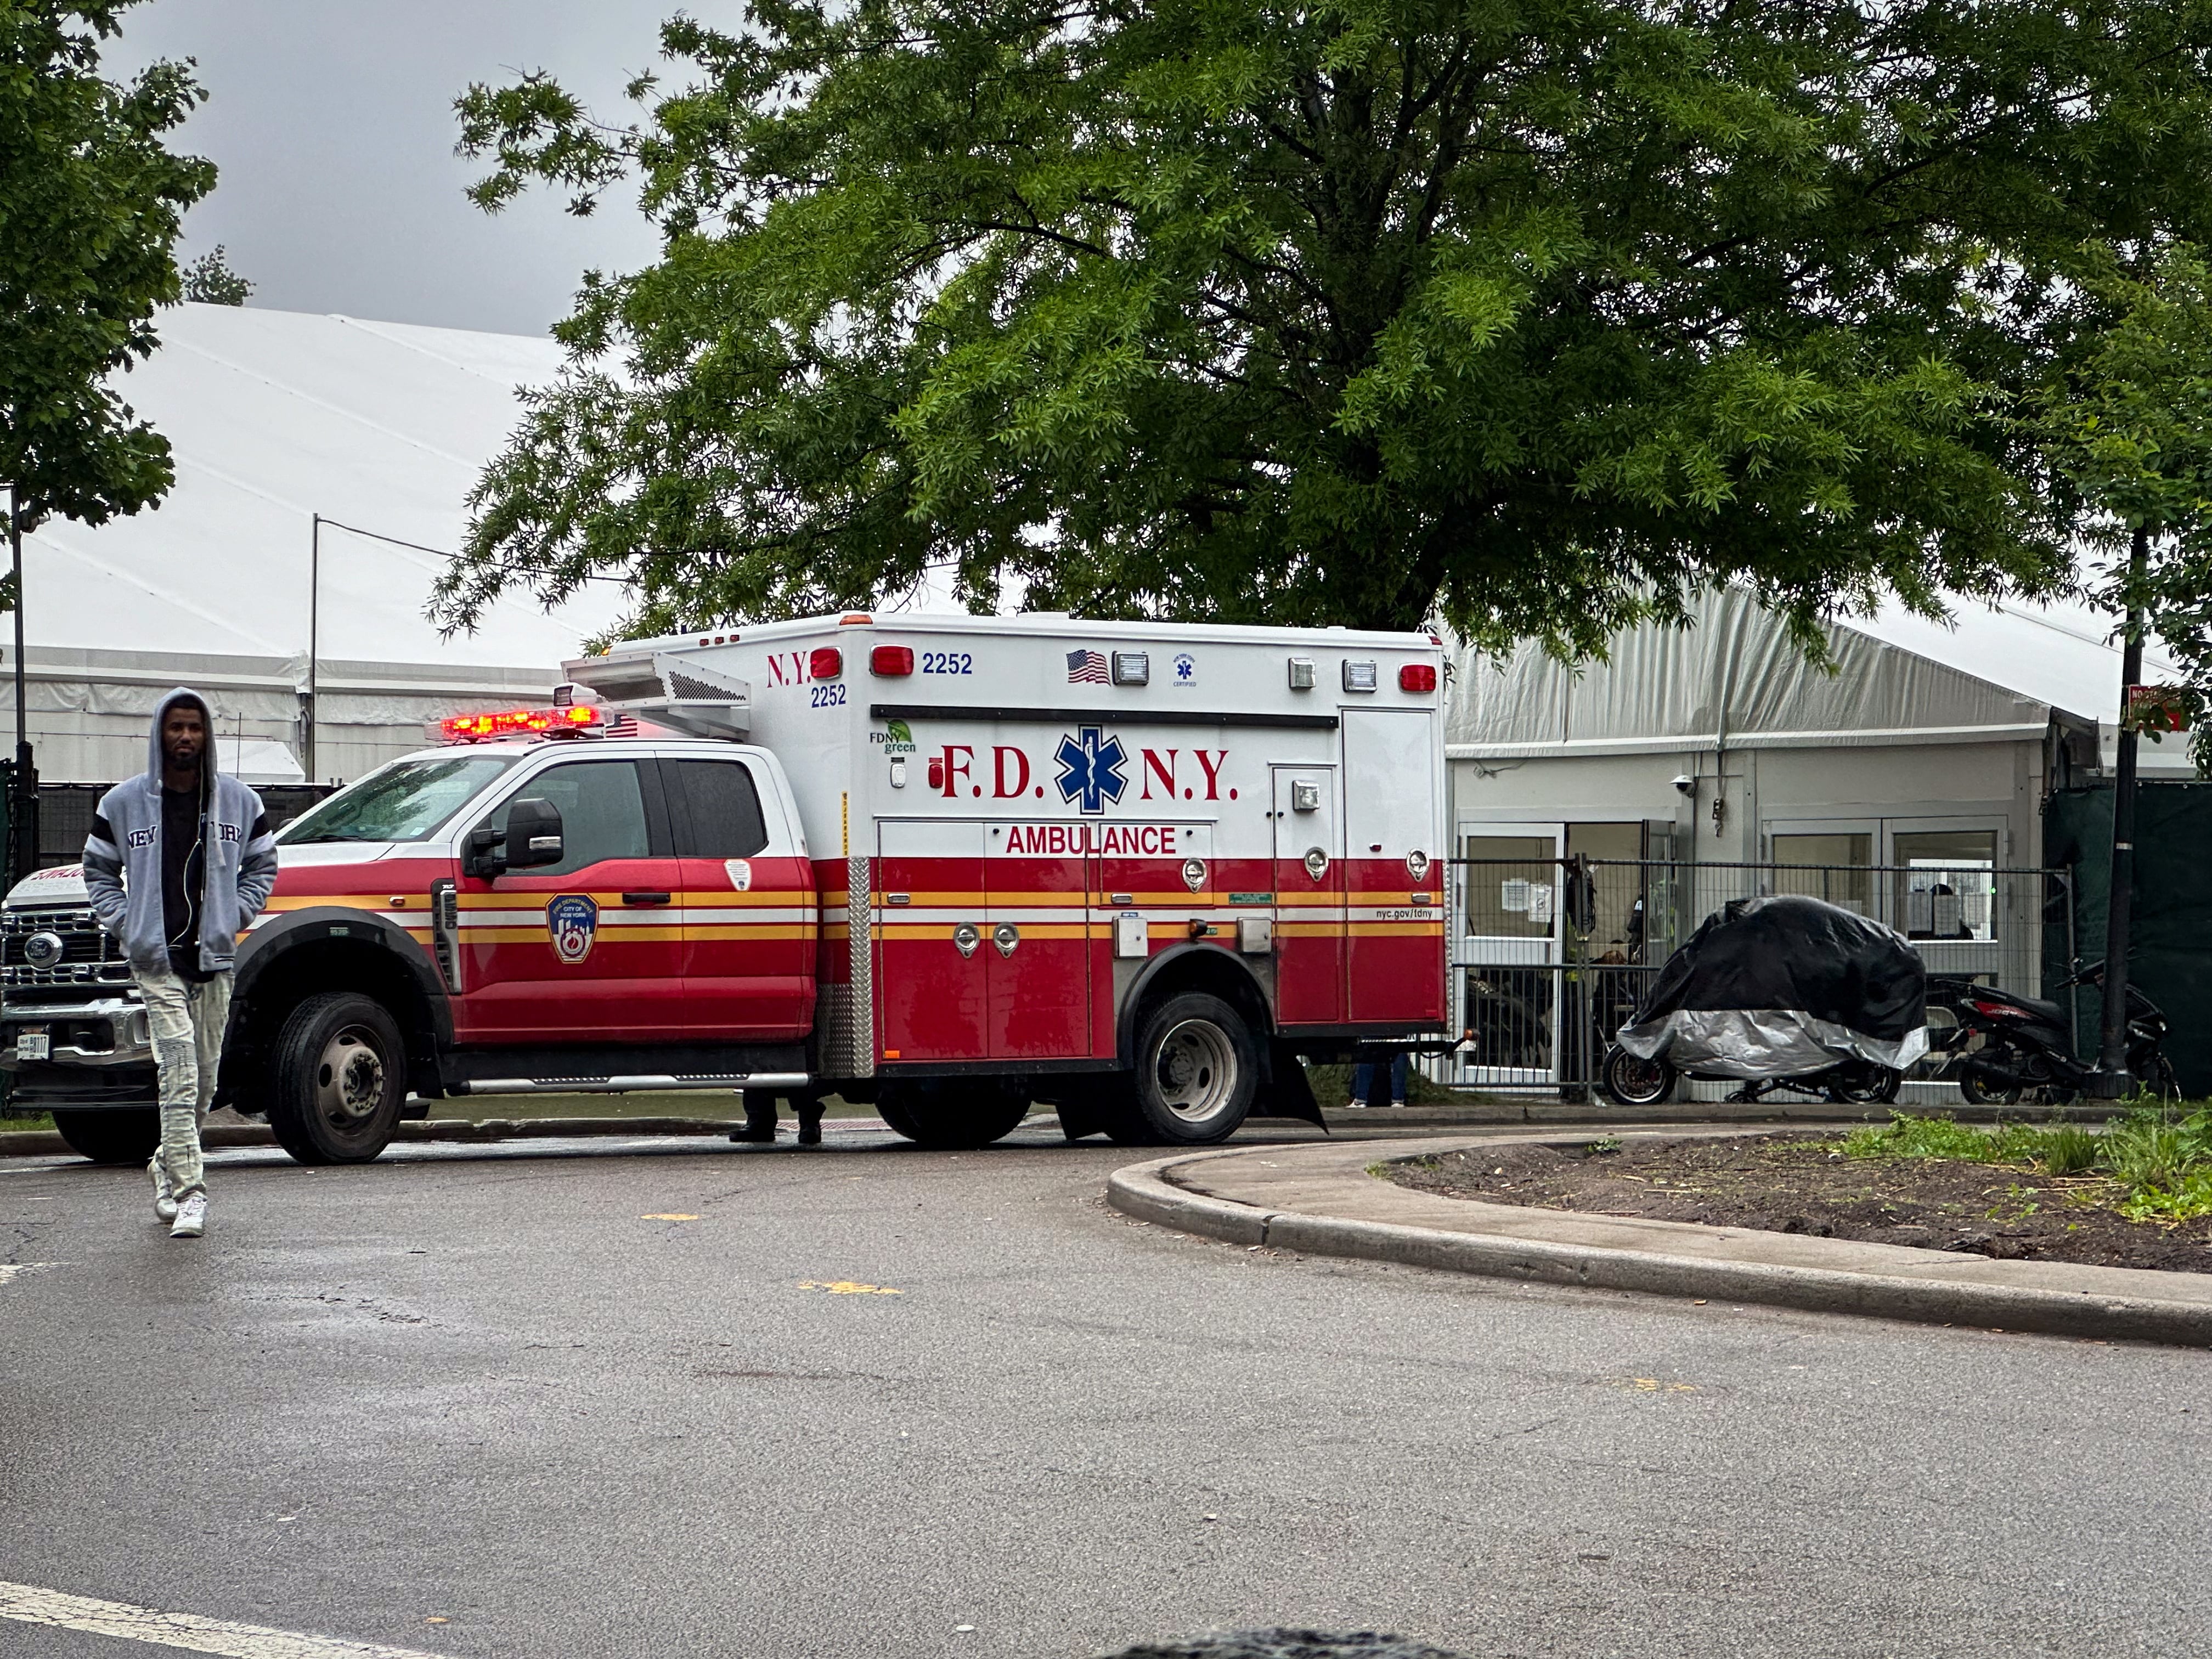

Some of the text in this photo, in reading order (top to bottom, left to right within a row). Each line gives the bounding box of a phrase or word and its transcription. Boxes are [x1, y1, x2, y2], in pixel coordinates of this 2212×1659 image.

[767, 651, 810, 688] N.Y.
[922, 652, 972, 674] 2252
[811, 684, 846, 708] 2252
[2132, 690, 2143, 698] NO
[870, 732, 900, 743] FDNY
[884, 743, 916, 754] green
[941, 745, 1238, 800] F.D. N.Y.
[1006, 826, 1177, 854] AMBULANCE
[562, 899, 593, 913] DEPARTMENT
[1376, 909, 1432, 920] nyc.gov/fdny
